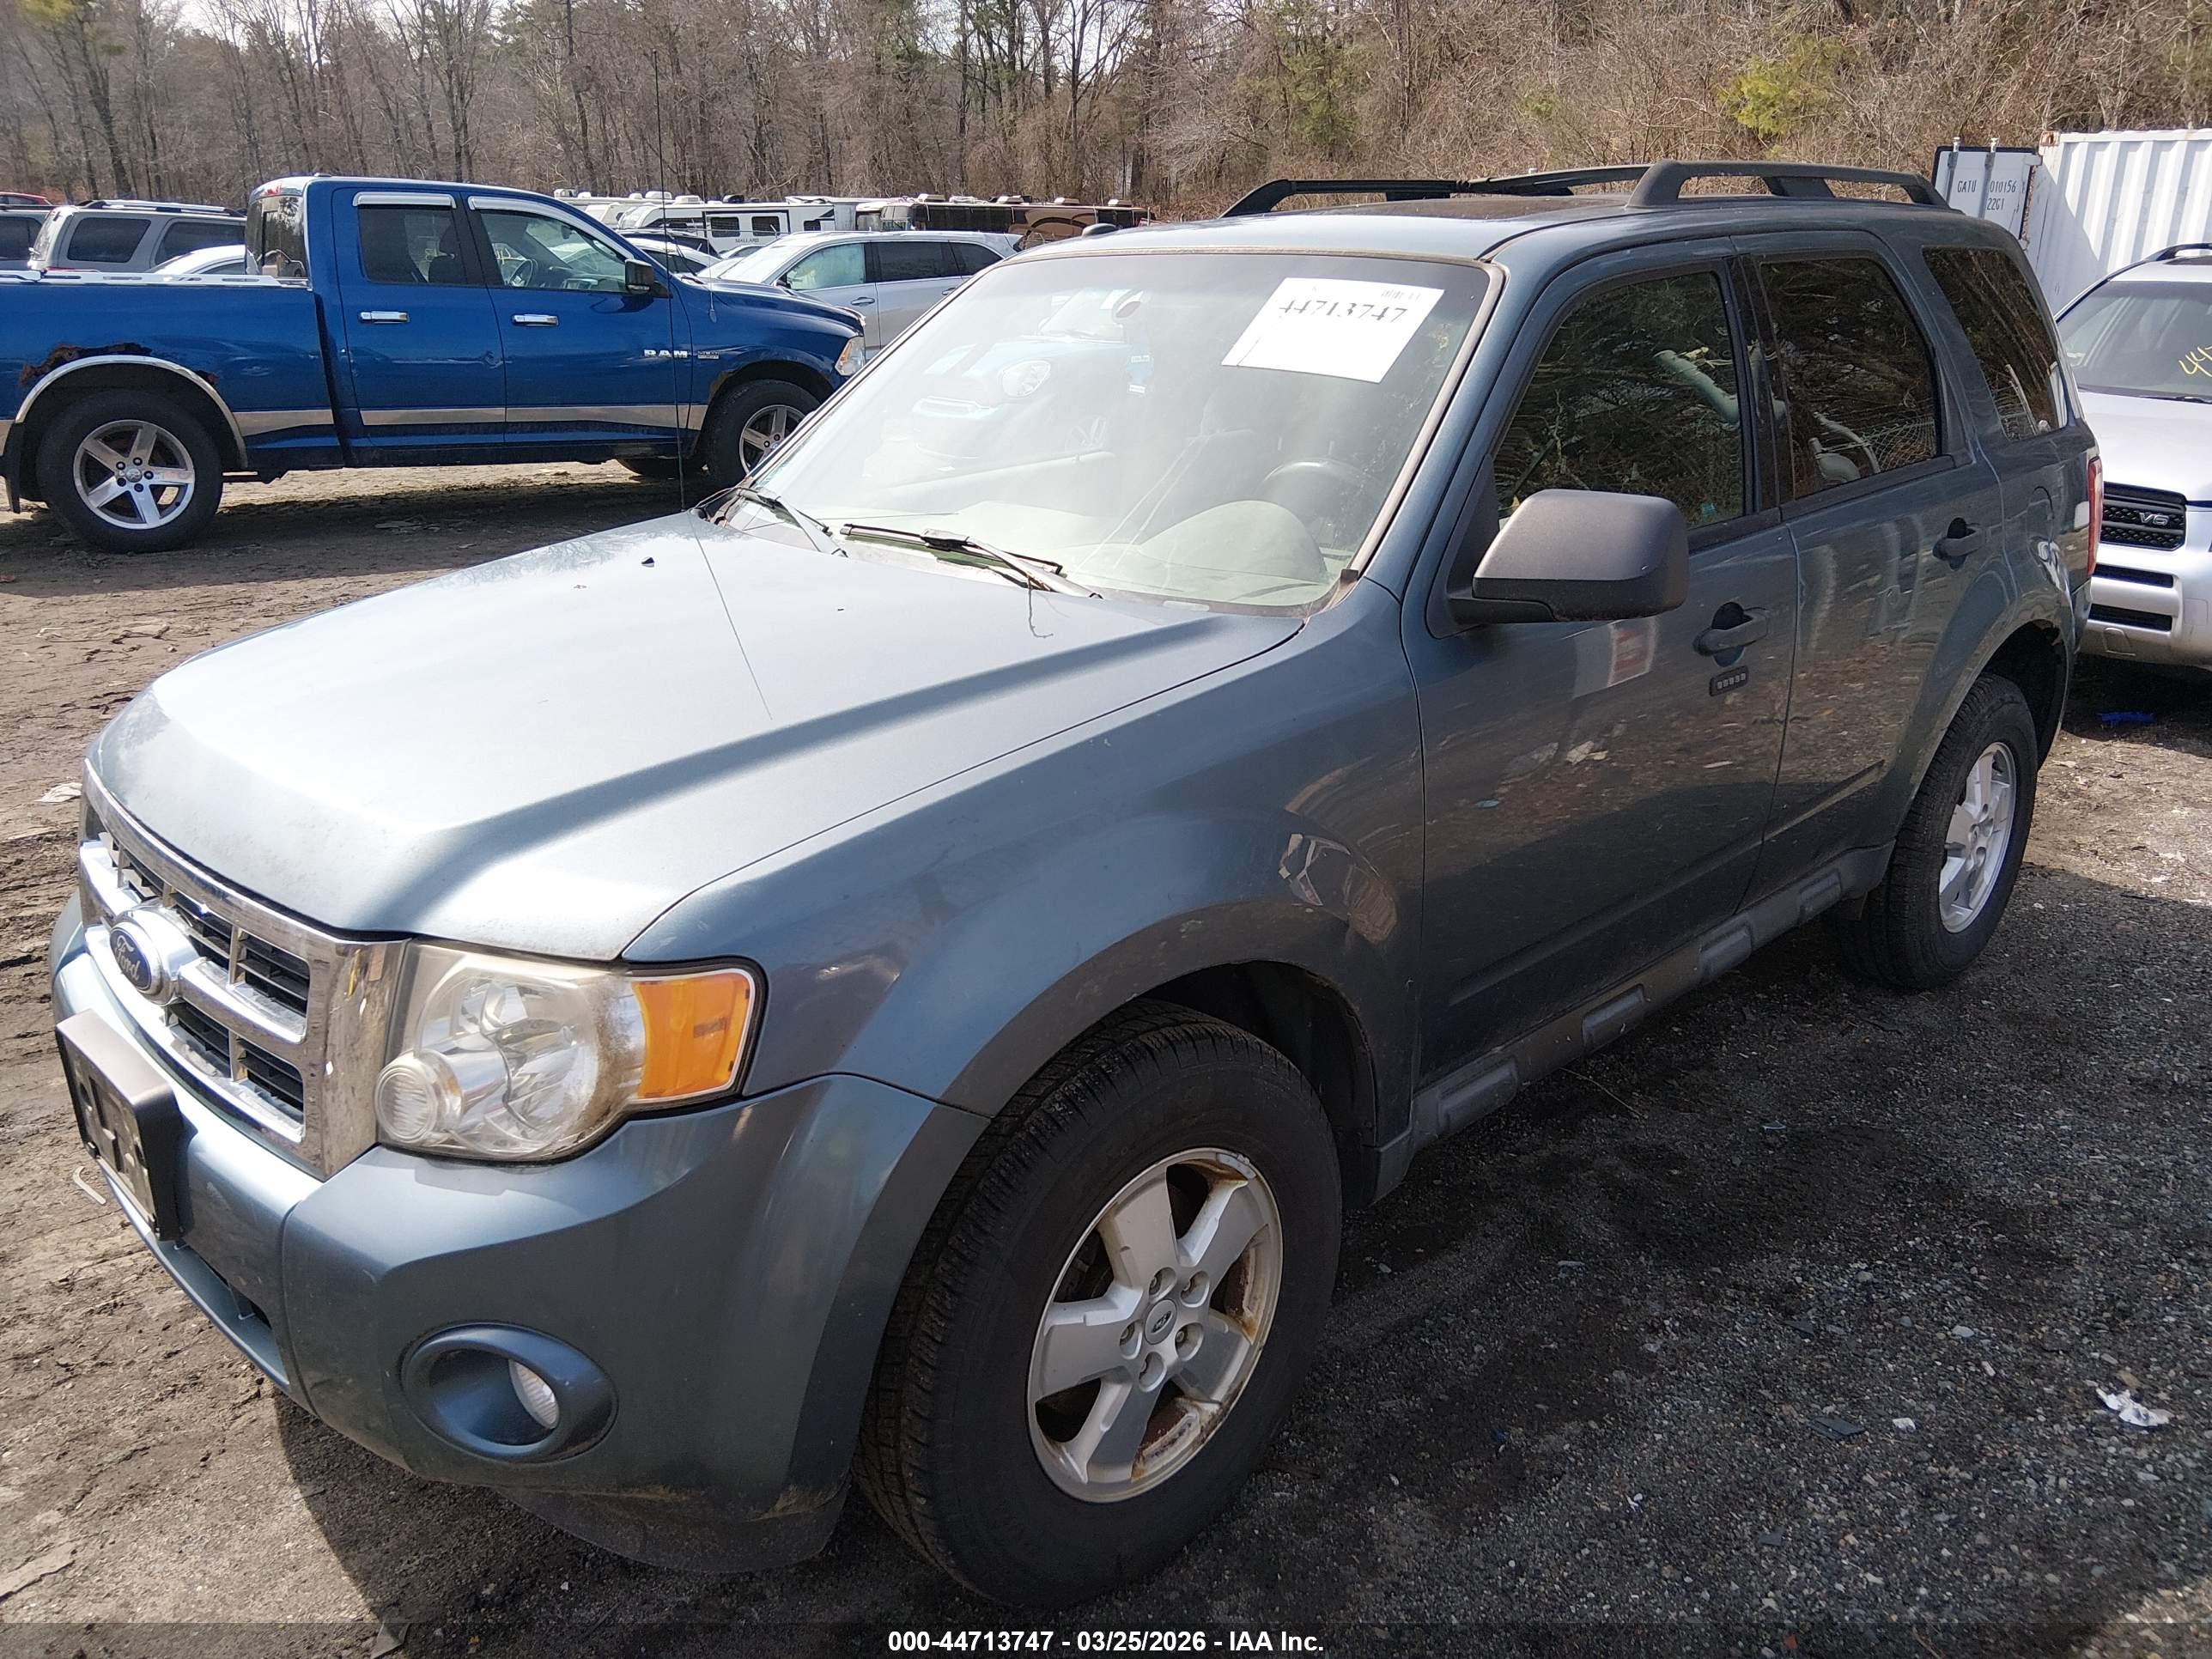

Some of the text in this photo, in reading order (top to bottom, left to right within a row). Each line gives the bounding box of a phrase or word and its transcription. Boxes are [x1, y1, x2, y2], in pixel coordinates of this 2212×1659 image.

[1990, 179, 2017, 193] 010156
[1279, 299, 1408, 324] 44713747
[643, 349, 688, 358] RAM
[2139, 512, 2169, 526] V6
[114, 934, 141, 981] Ford
